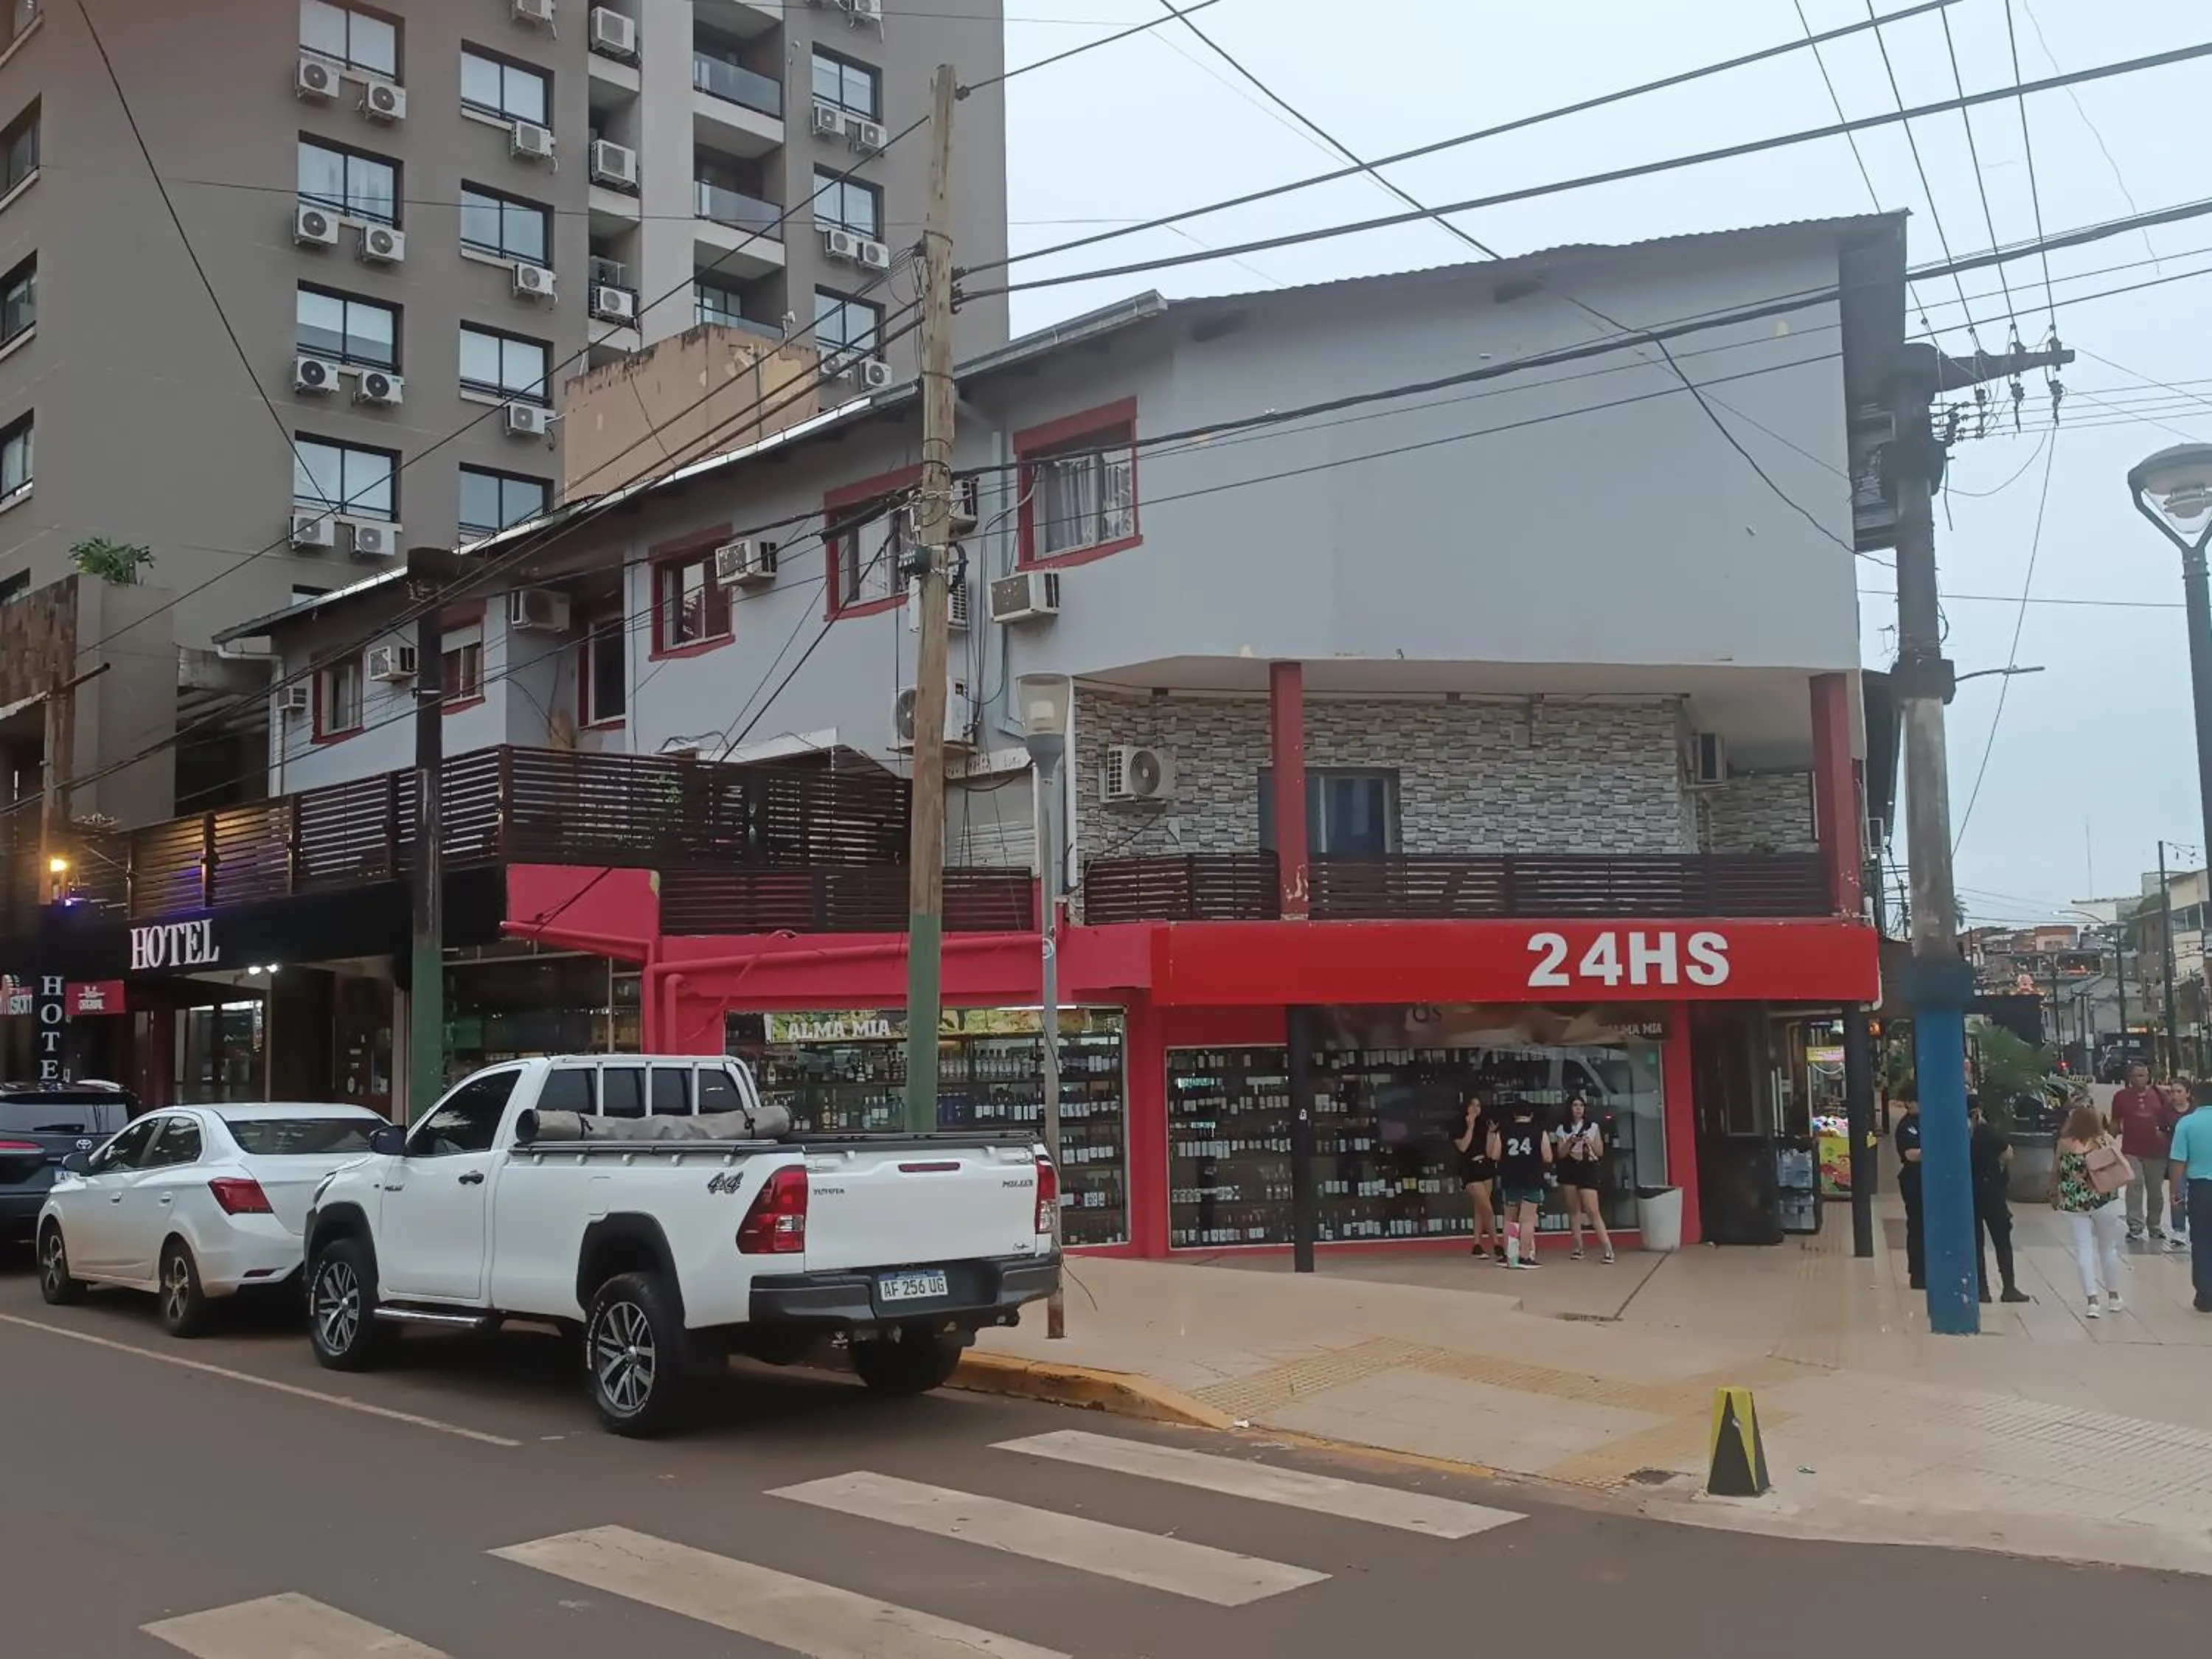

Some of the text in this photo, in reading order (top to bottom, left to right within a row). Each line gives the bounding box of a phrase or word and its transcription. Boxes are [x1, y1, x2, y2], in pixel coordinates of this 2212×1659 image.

[130, 919, 220, 970] HOTEL
[1527, 931, 1730, 987] 24HS
[40, 975, 64, 1079] HOTE
[787, 1020, 891, 1040] ALMA MIA
[1507, 1137, 1532, 1156] 24
[884, 1277, 945, 1297] AF 256 UG
